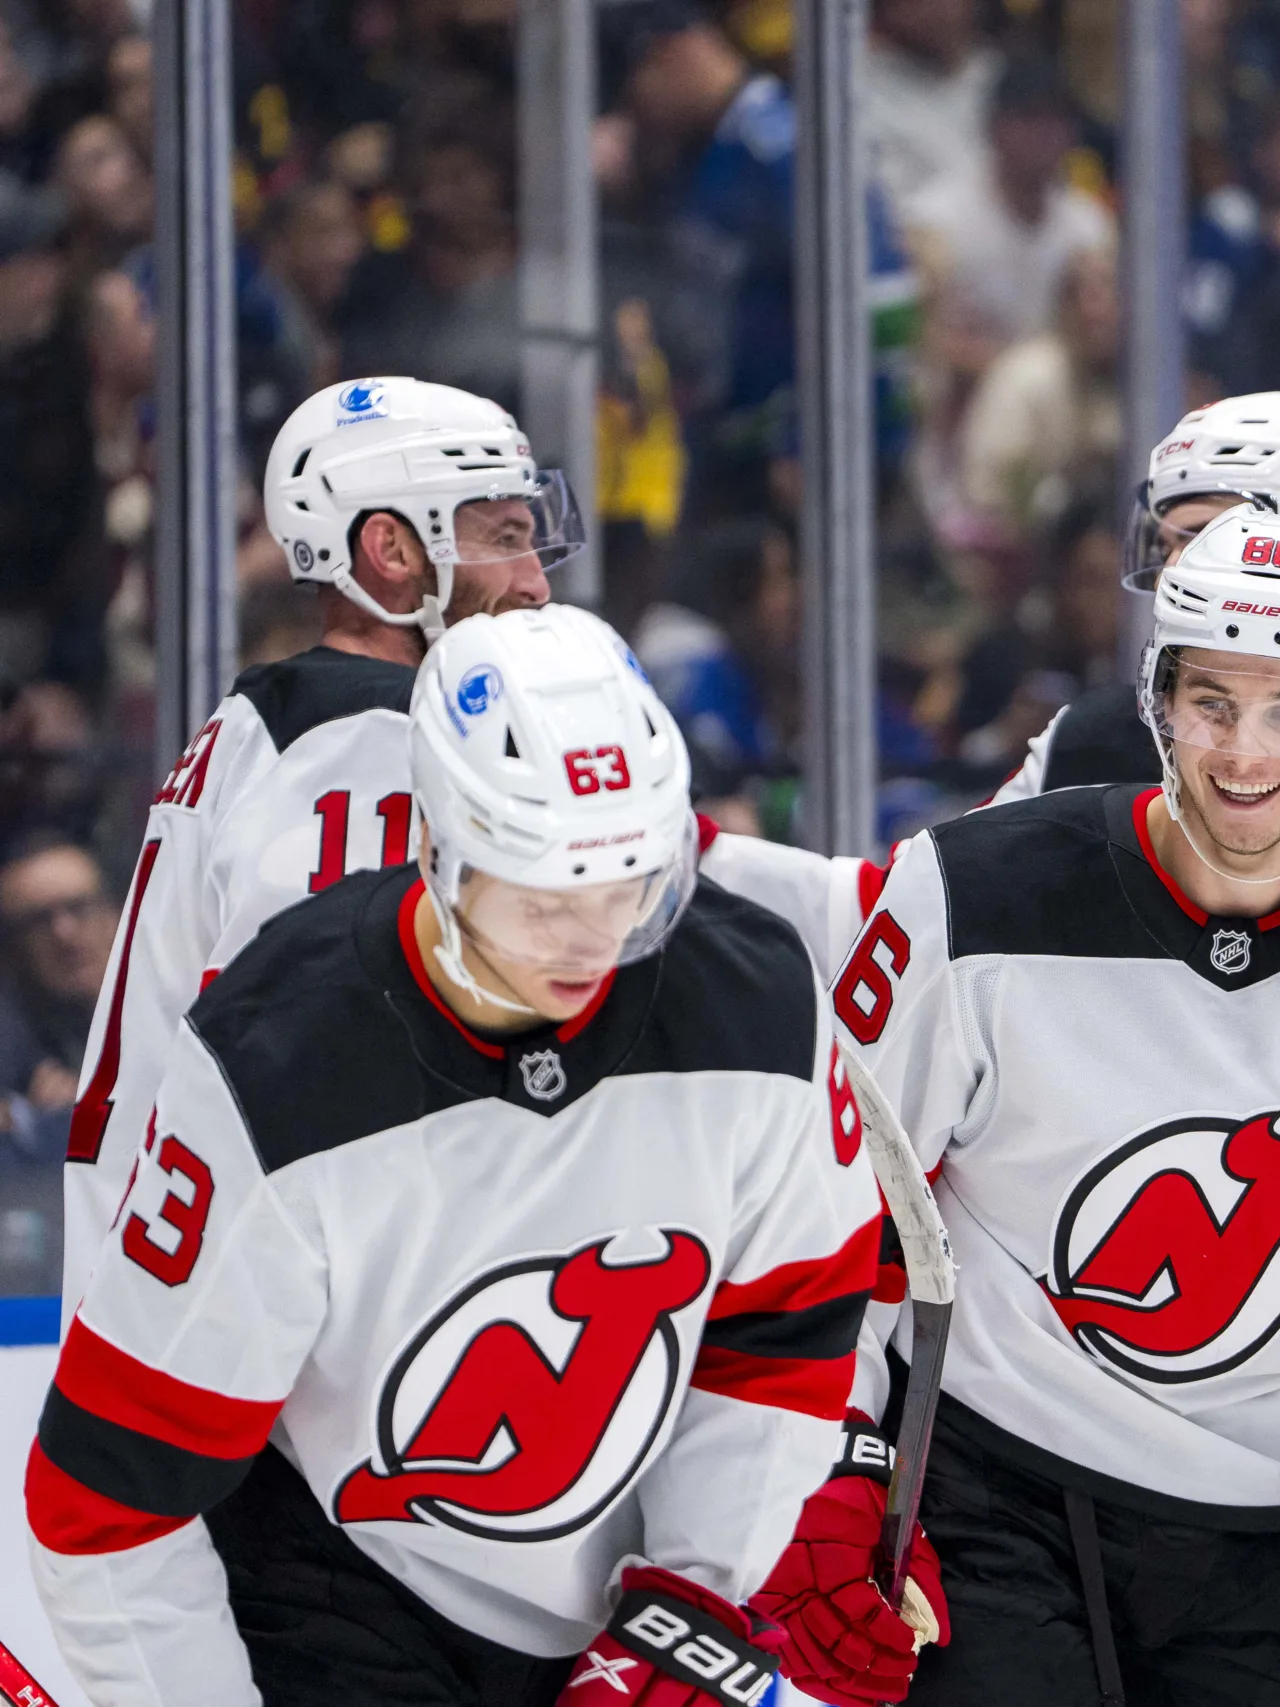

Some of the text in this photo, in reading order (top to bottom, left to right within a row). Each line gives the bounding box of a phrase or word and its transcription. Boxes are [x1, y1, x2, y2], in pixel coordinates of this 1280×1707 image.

[563, 744, 631, 797] 63
[308, 789, 413, 894] 11
[833, 908, 910, 1046] 6
[1219, 943, 1243, 963] NHL
[110, 1101, 214, 1287] 3
